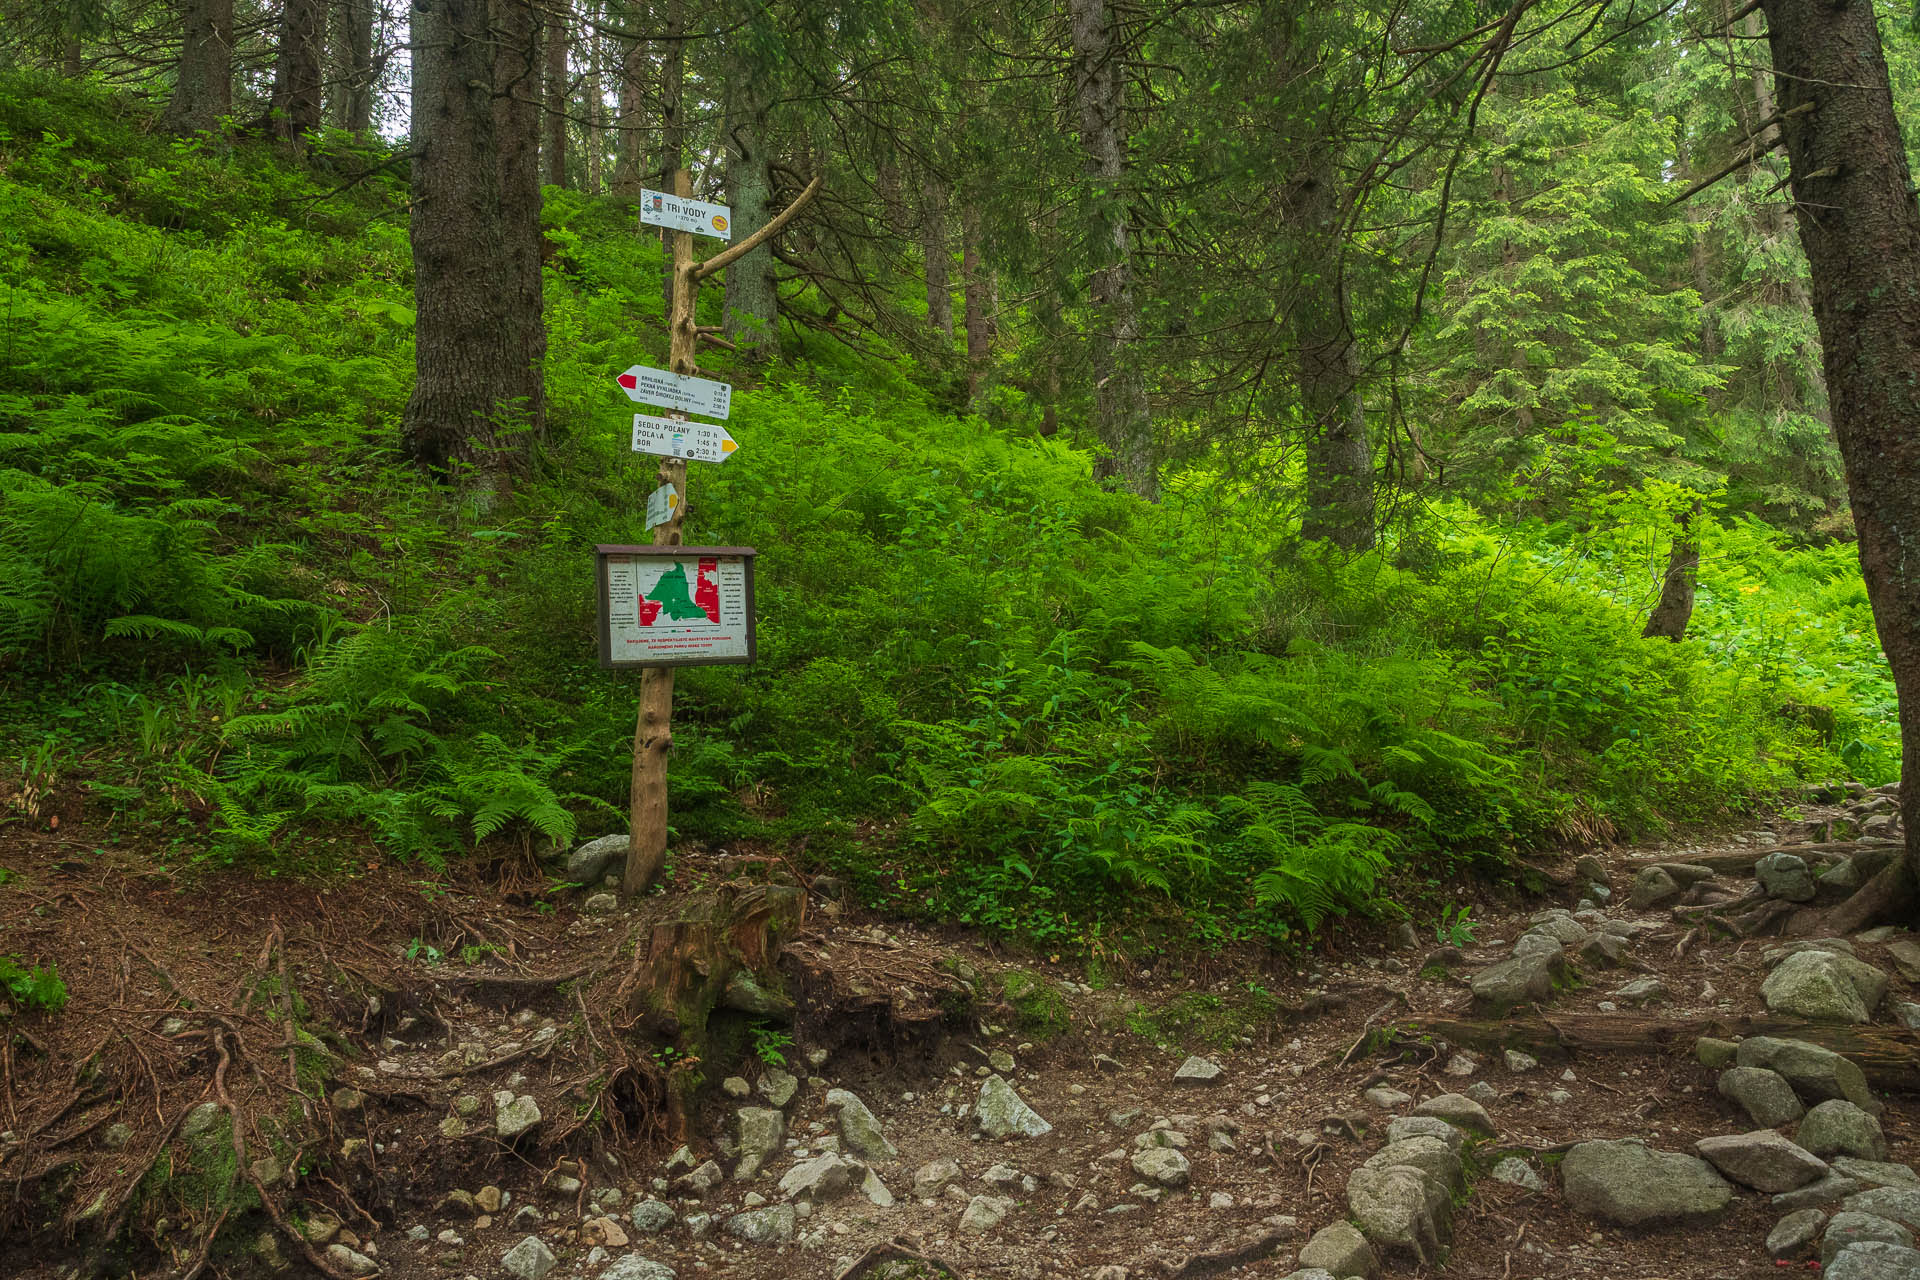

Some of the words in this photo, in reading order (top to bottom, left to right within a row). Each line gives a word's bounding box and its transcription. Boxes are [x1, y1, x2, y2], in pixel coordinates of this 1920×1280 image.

[666, 203, 680, 213] TRI
[683, 207, 706, 218] VODY
[637, 421, 660, 430] SEDLO
[697, 430, 711, 438] 1:30
[697, 439, 710, 447] 1:45
[695, 447, 710, 455] 2:30
